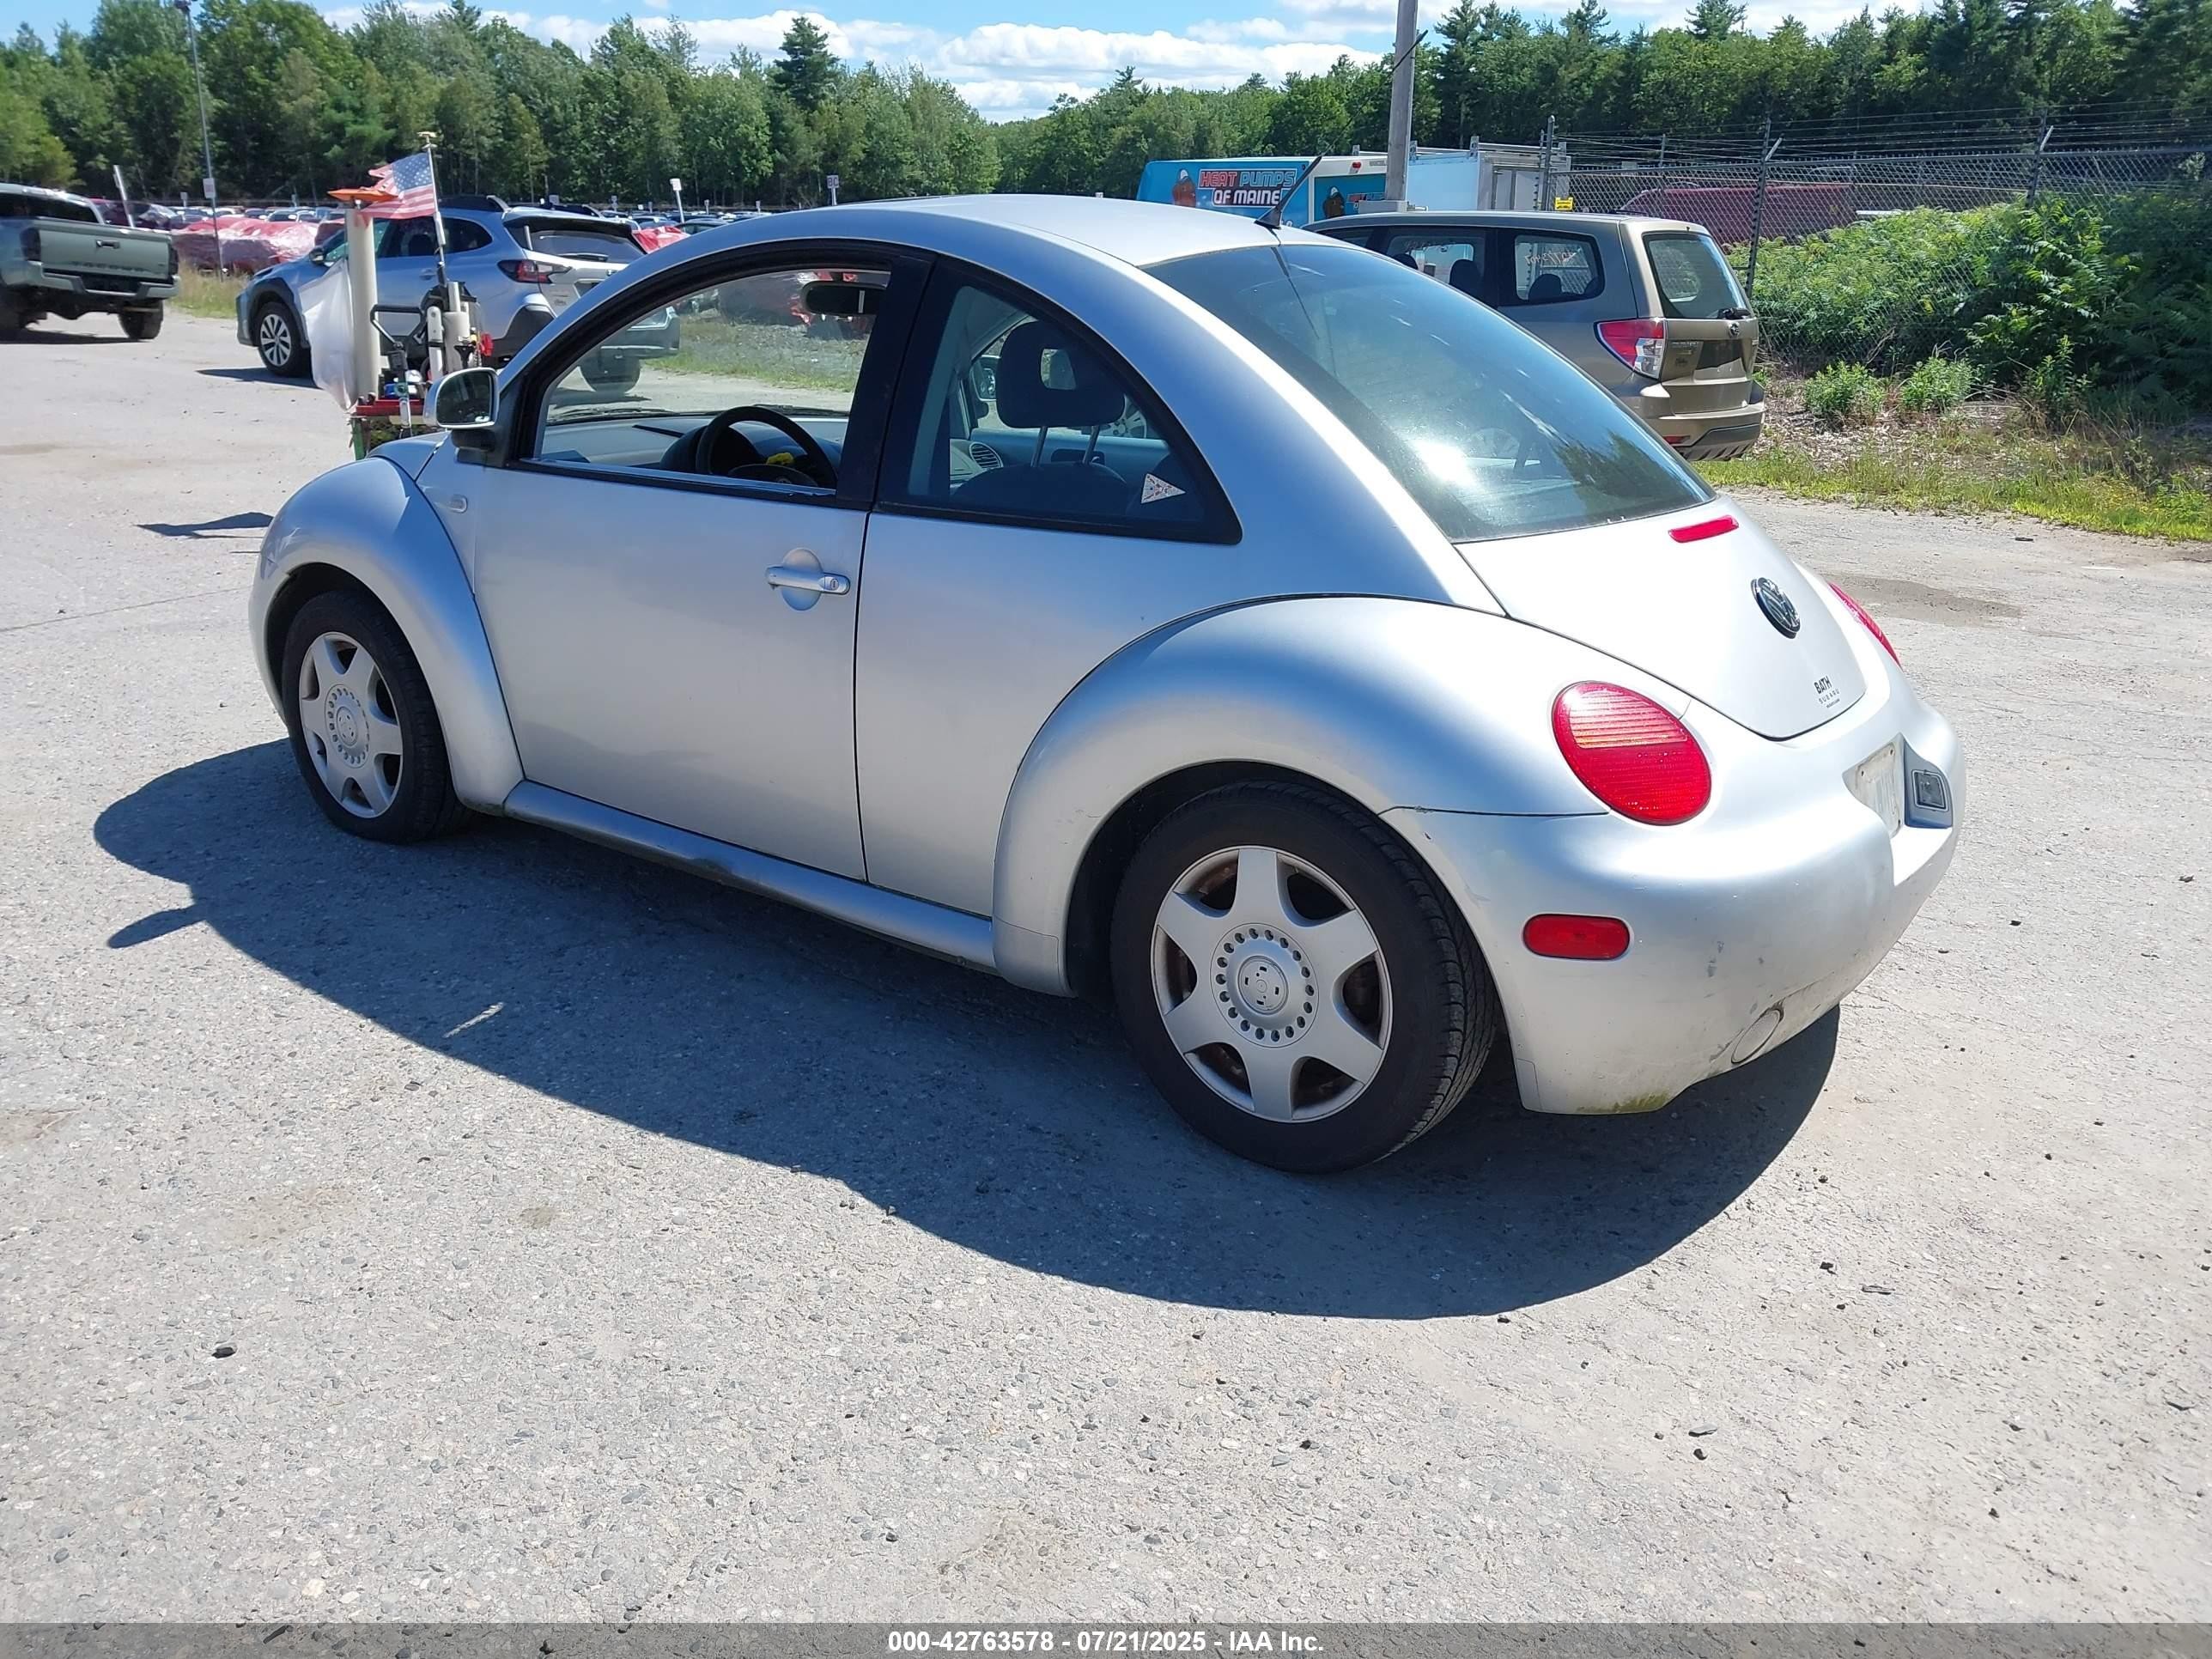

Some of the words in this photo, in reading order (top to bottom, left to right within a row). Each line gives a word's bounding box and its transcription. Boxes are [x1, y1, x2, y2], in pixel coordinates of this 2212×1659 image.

[1201, 172, 1237, 186] HEAT
[1240, 172, 1294, 186] PUMPS
[1214, 190, 1231, 204] OF
[1234, 190, 1279, 204] MAINE
[1814, 676, 1832, 694] BATH
